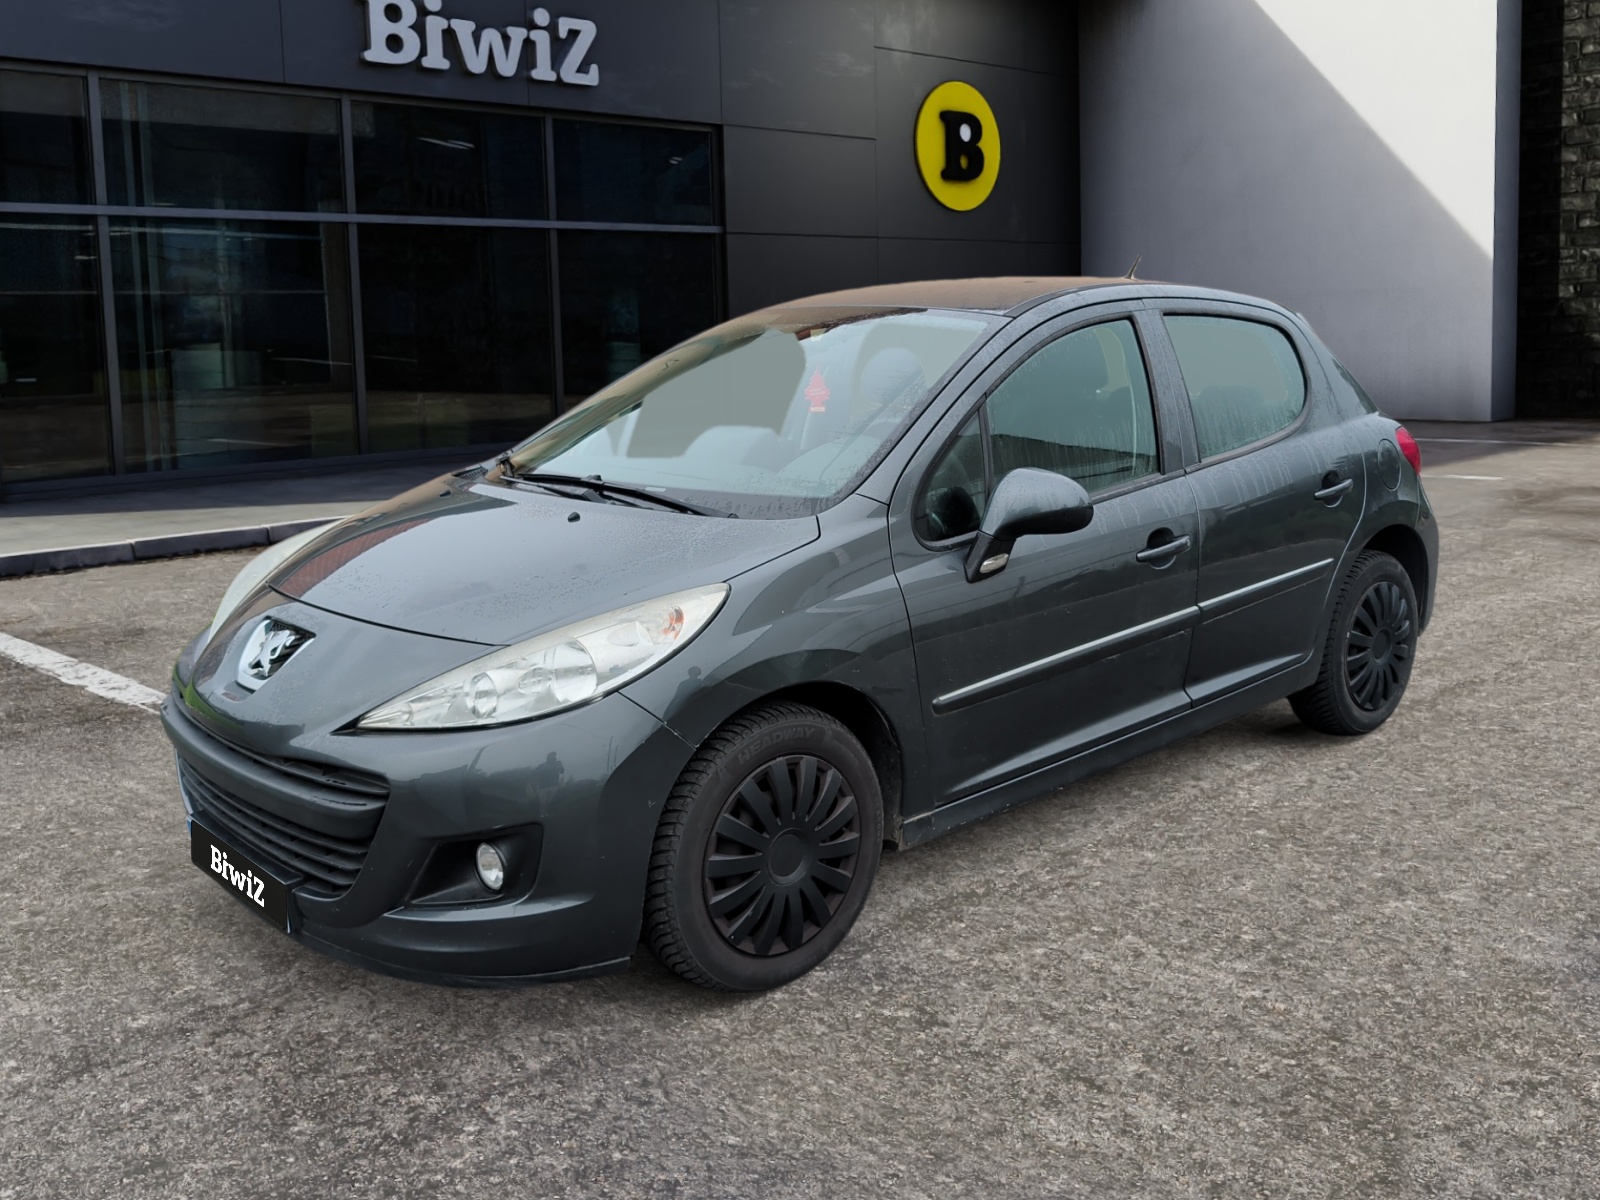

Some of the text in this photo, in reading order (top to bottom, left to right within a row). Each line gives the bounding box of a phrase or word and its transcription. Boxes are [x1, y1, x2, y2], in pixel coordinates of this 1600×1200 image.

[363, 0, 600, 86] BiwiZ
[939, 110, 985, 182] B
[737, 727, 815, 764] HEADWAY
[210, 844, 265, 908] BiwiZ
